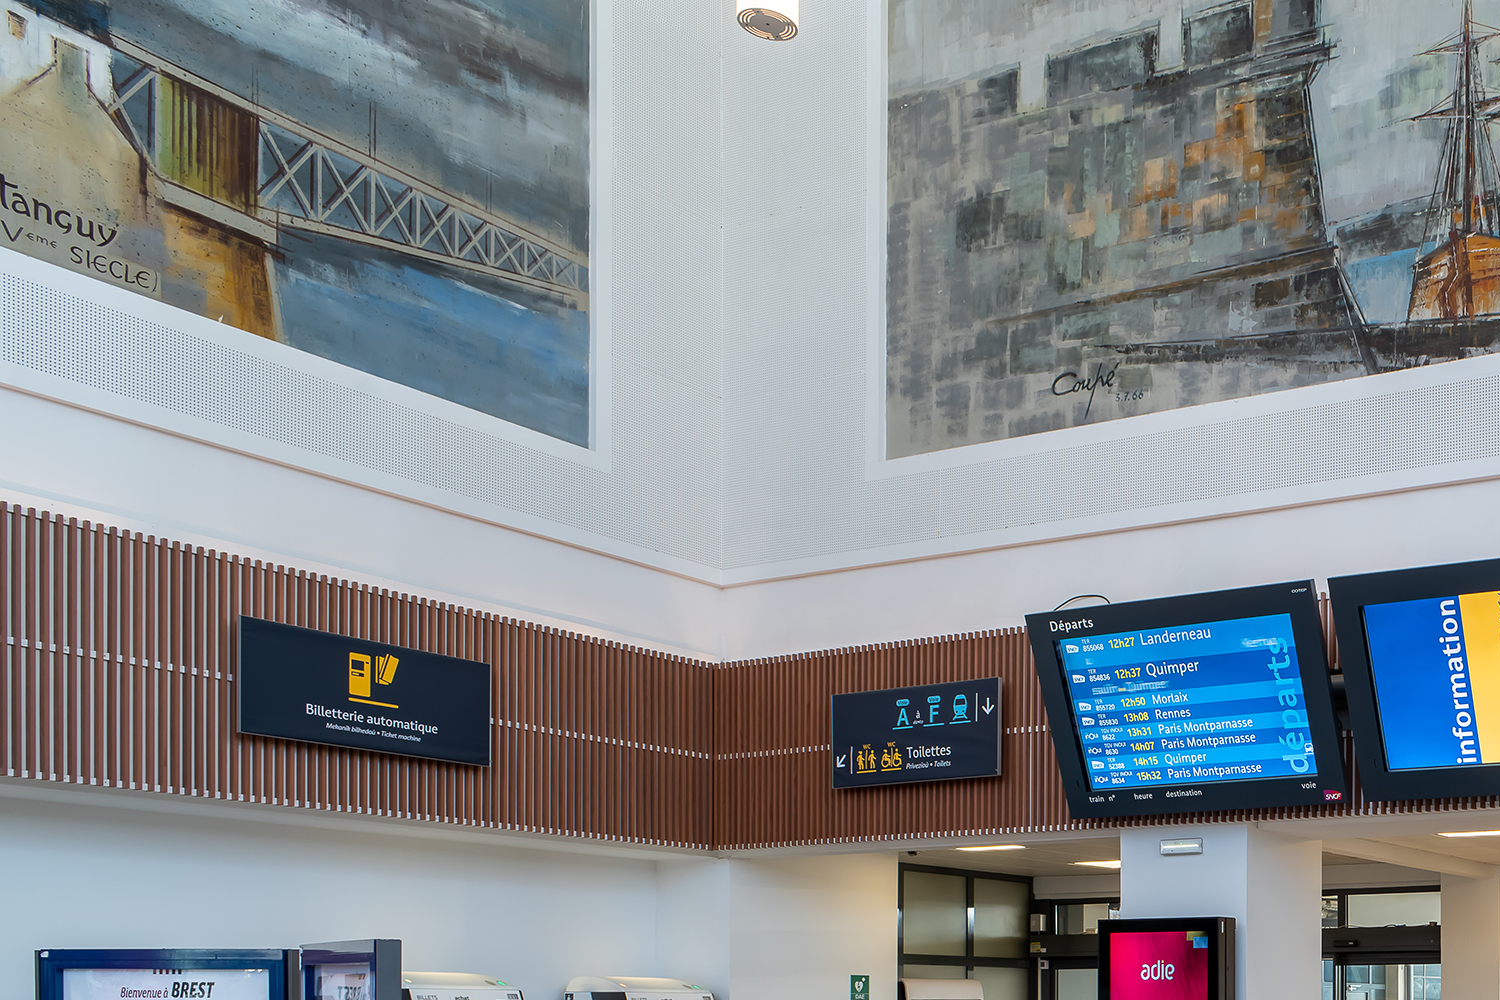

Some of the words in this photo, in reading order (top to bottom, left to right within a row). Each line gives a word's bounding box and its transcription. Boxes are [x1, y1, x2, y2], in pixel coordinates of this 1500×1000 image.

[69, 246, 158, 293] SIECLE)
[1051, 362, 1119, 419] Coupé
[1115, 390, 1144, 402] 3.7.66
[1049, 618, 1094, 633] Départs
[1108, 637, 1135, 649] 12h27
[1139, 629, 1212, 646] Landerneau
[1114, 667, 1141, 680] 12h37
[1146, 661, 1199, 677] Quimper
[1439, 599, 1478, 764] information
[1120, 697, 1146, 707] 12h50
[1151, 693, 1189, 705] Morlaix
[1267, 637, 1309, 773] départs
[306, 703, 364, 723] Billetterie
[366, 715, 439, 735] automatique
[896, 707, 910, 726] A
[929, 704, 940, 723] F
[1155, 708, 1191, 720] Rennes
[381, 731, 398, 739] Ticket
[398, 734, 422, 742] machine
[1127, 727, 1152, 737] 13h31
[1158, 724, 1181, 735] Paris
[1183, 718, 1253, 733] Montparnasse
[1130, 742, 1154, 752] 14h07
[1161, 738, 1185, 749] Paris
[1187, 733, 1256, 748] Montparnasse
[906, 745, 951, 759] Toilettes
[1133, 756, 1158, 766] 14h15
[1164, 752, 1207, 766] Quimper
[933, 759, 951, 768] Toilets
[1136, 770, 1161, 781] 15h32
[1167, 768, 1191, 779] Paris
[1193, 763, 1262, 778] Montparnasse
[1089, 795, 1105, 803] train
[1133, 792, 1153, 800] heure
[1140, 960, 1175, 980] adie
[120, 986, 162, 998] Bienvenue
[163, 988, 169, 998] à
[171, 981, 215, 998] BREST
